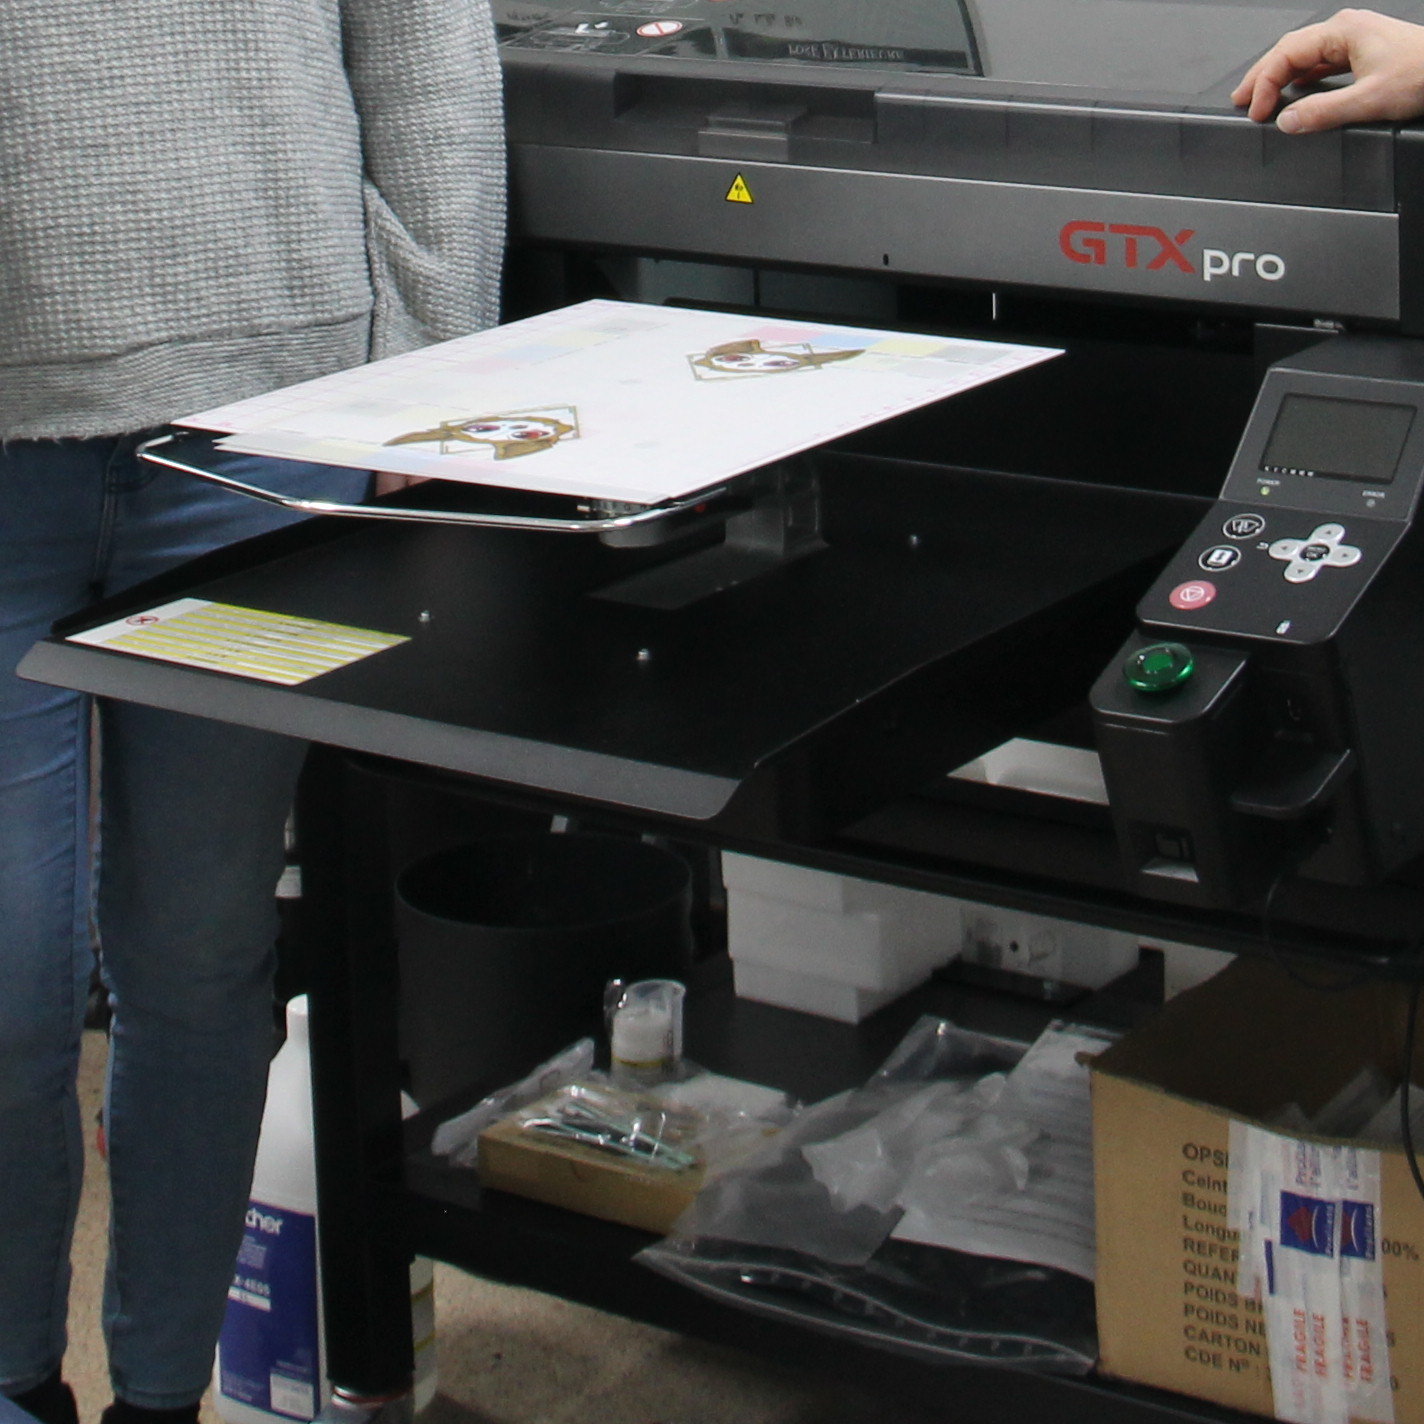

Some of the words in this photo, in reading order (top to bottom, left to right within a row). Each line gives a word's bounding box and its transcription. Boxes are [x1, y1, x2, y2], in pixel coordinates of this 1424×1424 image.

[1059, 219, 1196, 274] GTX
[1203, 248, 1286, 282] pro
[1182, 1143, 1228, 1167] OPS
[245, 1207, 283, 1236] ther
[1381, 1238, 1419, 1263] 00%
[1183, 1281, 1238, 1308] POIDS
[1183, 1303, 1239, 1330] POIDS
[1183, 1325, 1260, 1356] CARTON
[1293, 1307, 1308, 1373] FRAGILE
[1312, 1312, 1328, 1378] FRAGILE
[1356, 1318, 1373, 1382] FRAGILE
[1184, 1346, 1224, 1369] CDE
